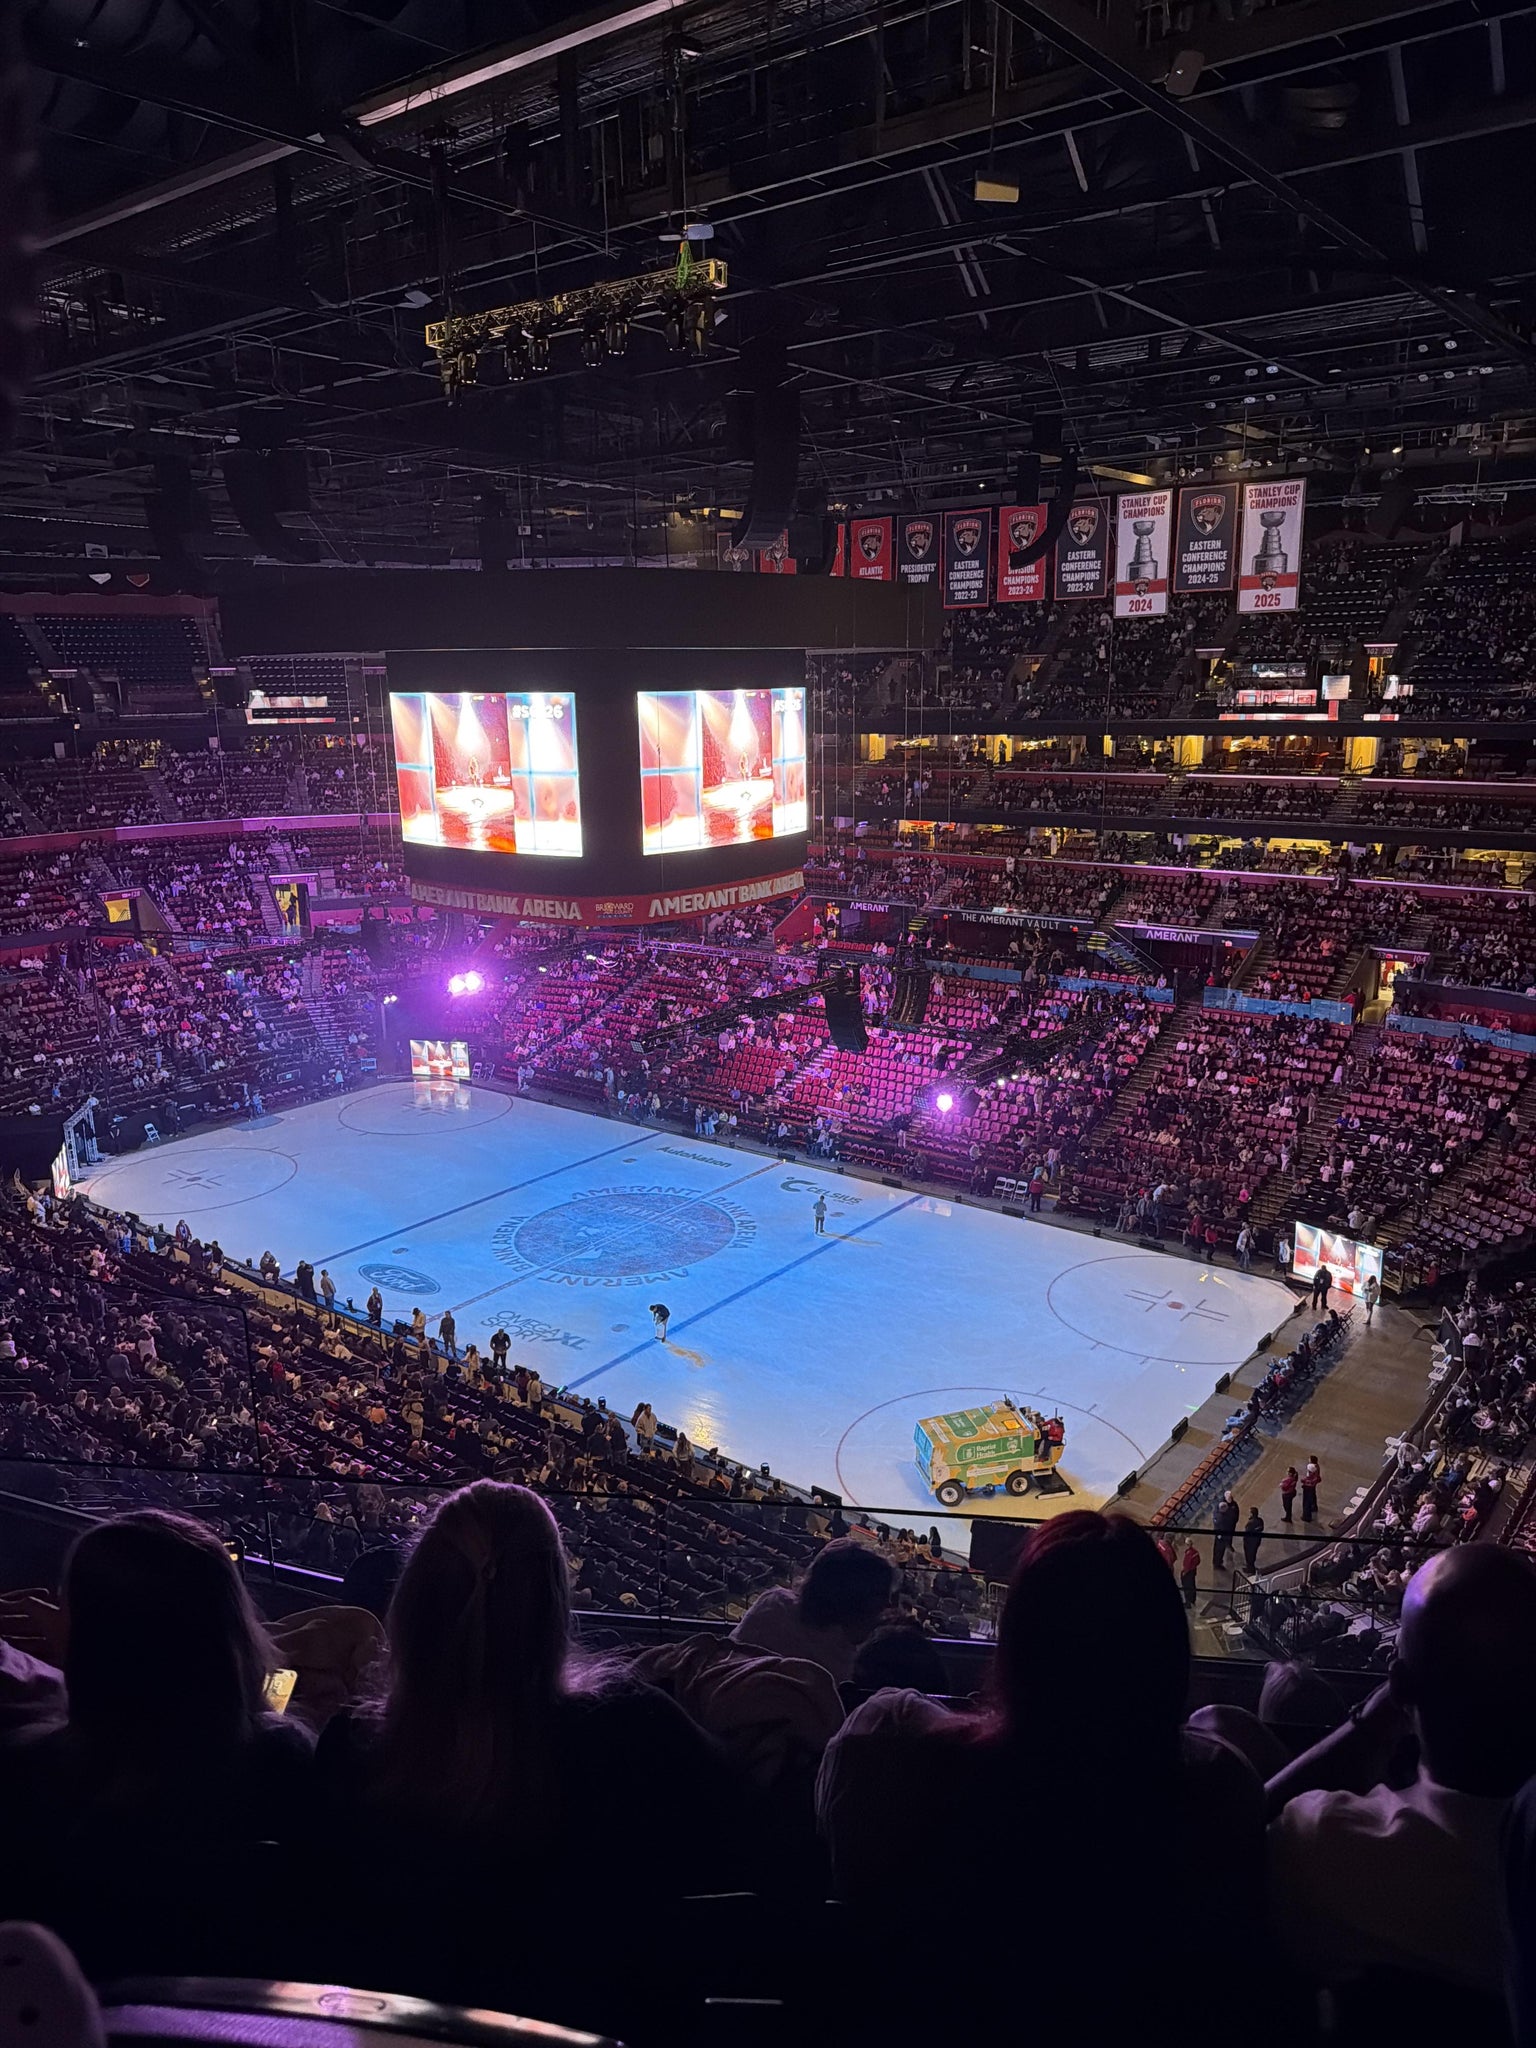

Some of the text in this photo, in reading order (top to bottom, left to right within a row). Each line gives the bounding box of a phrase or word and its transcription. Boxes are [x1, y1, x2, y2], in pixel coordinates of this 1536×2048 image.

[1248, 484, 1301, 499] STANLEY CUP
[1121, 494, 1168, 509] STANLEY CUP
[1249, 496, 1297, 510] CHAMPIONS
[1123, 506, 1165, 520] CHAMPIONS
[1189, 540, 1222, 551] EASTERN
[1067, 550, 1096, 561] EASTERN
[1182, 551, 1228, 563] CONFERENCE
[859, 566, 884, 576] ATLANTIC
[900, 563, 937, 574] PRESIDENTS'
[954, 560, 979, 570] EASTERN
[1008, 565, 1035, 575] DIVISION
[1061, 560, 1102, 572] CONFERENCE
[1182, 562, 1226, 574] CHAMPIONS
[907, 574, 930, 584] TROPHY
[949, 569, 984, 580] CONFERENCE
[1003, 575, 1040, 586] CHAMPIONS
[1062, 571, 1100, 582] CHAMPIONS
[1188, 573, 1219, 584] 2024-25
[950, 580, 983, 591] CHAMPIONS
[1008, 586, 1034, 596] 2023-24
[1067, 582, 1094, 593] 2023-24
[954, 590, 978, 600] 2022-23
[1254, 593, 1281, 607] 2025
[1128, 598, 1153, 612] 2024
[648, 871, 805, 918] AMERANT BANK ARENA
[411, 883, 583, 921] AMERANT BANK ARENA
[849, 901, 889, 913] AMERANT
[961, 912, 1060, 930] THE AMERANT VAULT
[1146, 930, 1200, 943] AMERANT
[656, 1146, 732, 1169] AutoNation
[571, 1185, 703, 1200] AMERANT
[806, 1186, 864, 1204] CELSIUS
[708, 1196, 757, 1249] BANK ARENA
[491, 1216, 534, 1273] BANK ARENA
[369, 1267, 427, 1291] Ford
[537, 1268, 689, 1288] AMERANT
[481, 1317, 548, 1343] SPORT
[496, 1310, 561, 1338] OMEGA
